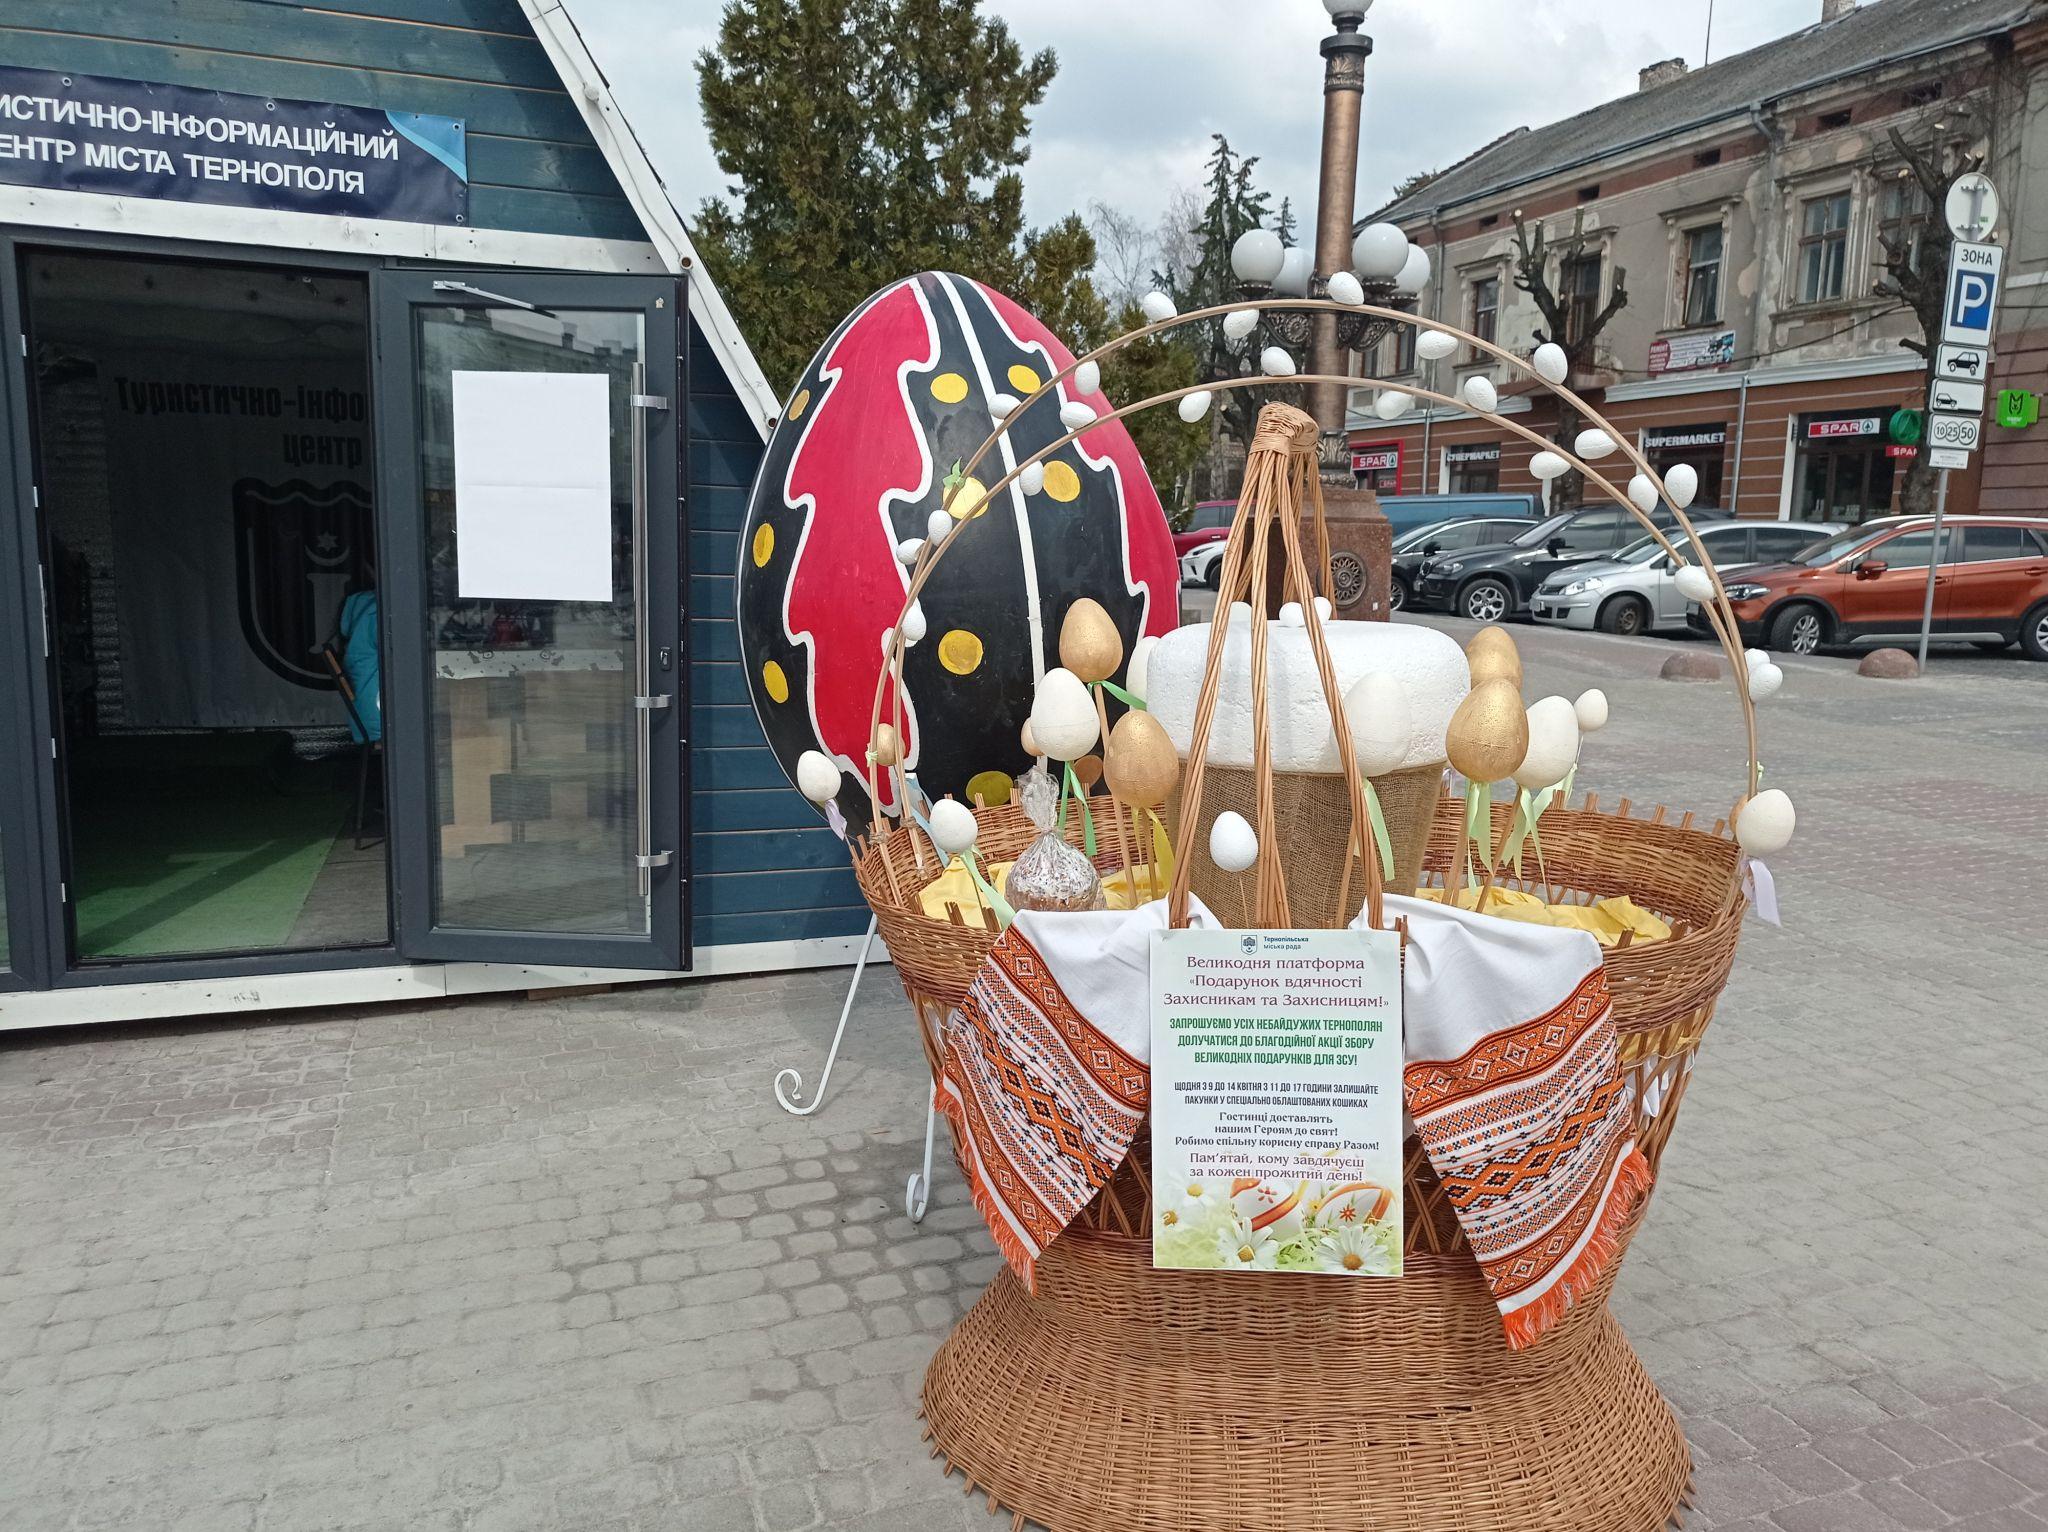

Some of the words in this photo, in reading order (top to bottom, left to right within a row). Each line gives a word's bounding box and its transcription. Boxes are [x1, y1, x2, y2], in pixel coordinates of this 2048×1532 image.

[85, 143, 176, 176] МІСТА
[183, 153, 365, 195] ТЕРНОПОЛЯ
[1961, 248, 1993, 266] ЗОНА
[1957, 275, 1987, 323] P
[114, 377, 368, 424] Туристично-інфо
[1820, 422, 1860, 434] SPAR
[1936, 426, 1945, 436] 10
[1946, 427, 1958, 437] 25
[1959, 428, 1973, 440] 50
[1644, 432, 1726, 448] SUPERMARKET
[282, 433, 363, 469] центр
[1359, 455, 1387, 468] SPAR
[1285, 943, 1301, 951] рада
[1187, 956, 1271, 970] Великодня
[1276, 958, 1365, 972] платформа
[1189, 975, 1278, 989] «Подарунок
[1285, 976, 1362, 989] вдячності
[1163, 993, 1256, 1006] Захисникам
[1261, 995, 1277, 1006] та
[1282, 994, 1389, 1008] Захисницям!»
[1169, 1018, 1232, 1030] ЗАПРОШУЄМО
[1233, 1018, 1255, 1030] УСІХ
[1256, 1017, 1321, 1032] НЕБАЙДУЖИХ
[1322, 1020, 1383, 1032] ТЕРНОПОЛЯН
[1177, 1035, 1238, 1047] ДОЛУЧАТИСЯ
[1239, 1036, 1253, 1047] ДО
[1254, 1035, 1317, 1048] БЛАГОДІЙНОЇ
[1318, 1036, 1343, 1049] АКЦІЇ
[1344, 1037, 1374, 1049] ЗБОРУ
[1194, 1052, 1252, 1064] ВЕЛИКОДНІХ
[1254, 1053, 1312, 1065] ПОДАРУНКІВ
[1313, 1054, 1334, 1066] ДЛЯ
[1336, 1055, 1358, 1066] ЗСУ!
[1174, 1081, 1201, 1092] ЩОДНЯ
[1208, 1082, 1214, 1091] 9
[1214, 1082, 1225, 1092] ДО
[1227, 1082, 1236, 1092] 14
[1236, 1082, 1262, 1092] КВІТНЯ
[1270, 1083, 1279, 1092] 11
[1280, 1083, 1291, 1093] ДО
[1293, 1083, 1301, 1093] 17
[1302, 1083, 1332, 1094] ГОДИНИ
[1333, 1084, 1379, 1095] ЗАЛИШАЙТЕ
[1184, 1096, 1219, 1105] ПАКУНКИ
[1219, 1096, 1225, 1105] У
[1226, 1096, 1271, 1106] СПЕЦІАЛЬНО
[1272, 1096, 1331, 1107] ОБЛАШТОВАНИХ
[1332, 1097, 1368, 1108] КОШИКАХ
[1219, 1112, 1268, 1124] Гостинці
[1269, 1113, 1333, 1124] доставлять
[1214, 1125, 1252, 1134] нашим
[1254, 1125, 1293, 1135] Героям
[1294, 1127, 1308, 1136] до
[1310, 1127, 1338, 1137] свят!
[1175, 1136, 1214, 1146] Робимо
[1216, 1137, 1257, 1148] спільну
[1259, 1138, 1303, 1149] корисну
[1304, 1140, 1341, 1150] справу
[1343, 1141, 1380, 1151] Разом!
[1258, 1154, 1290, 1166] кому
[1293, 1156, 1365, 1169] завдячуєш
[1189, 1168, 1204, 1178] за
[1207, 1168, 1251, 1178] кожен
[1255, 1169, 1323, 1181] прожитий
[1325, 1170, 1363, 1182] день!
